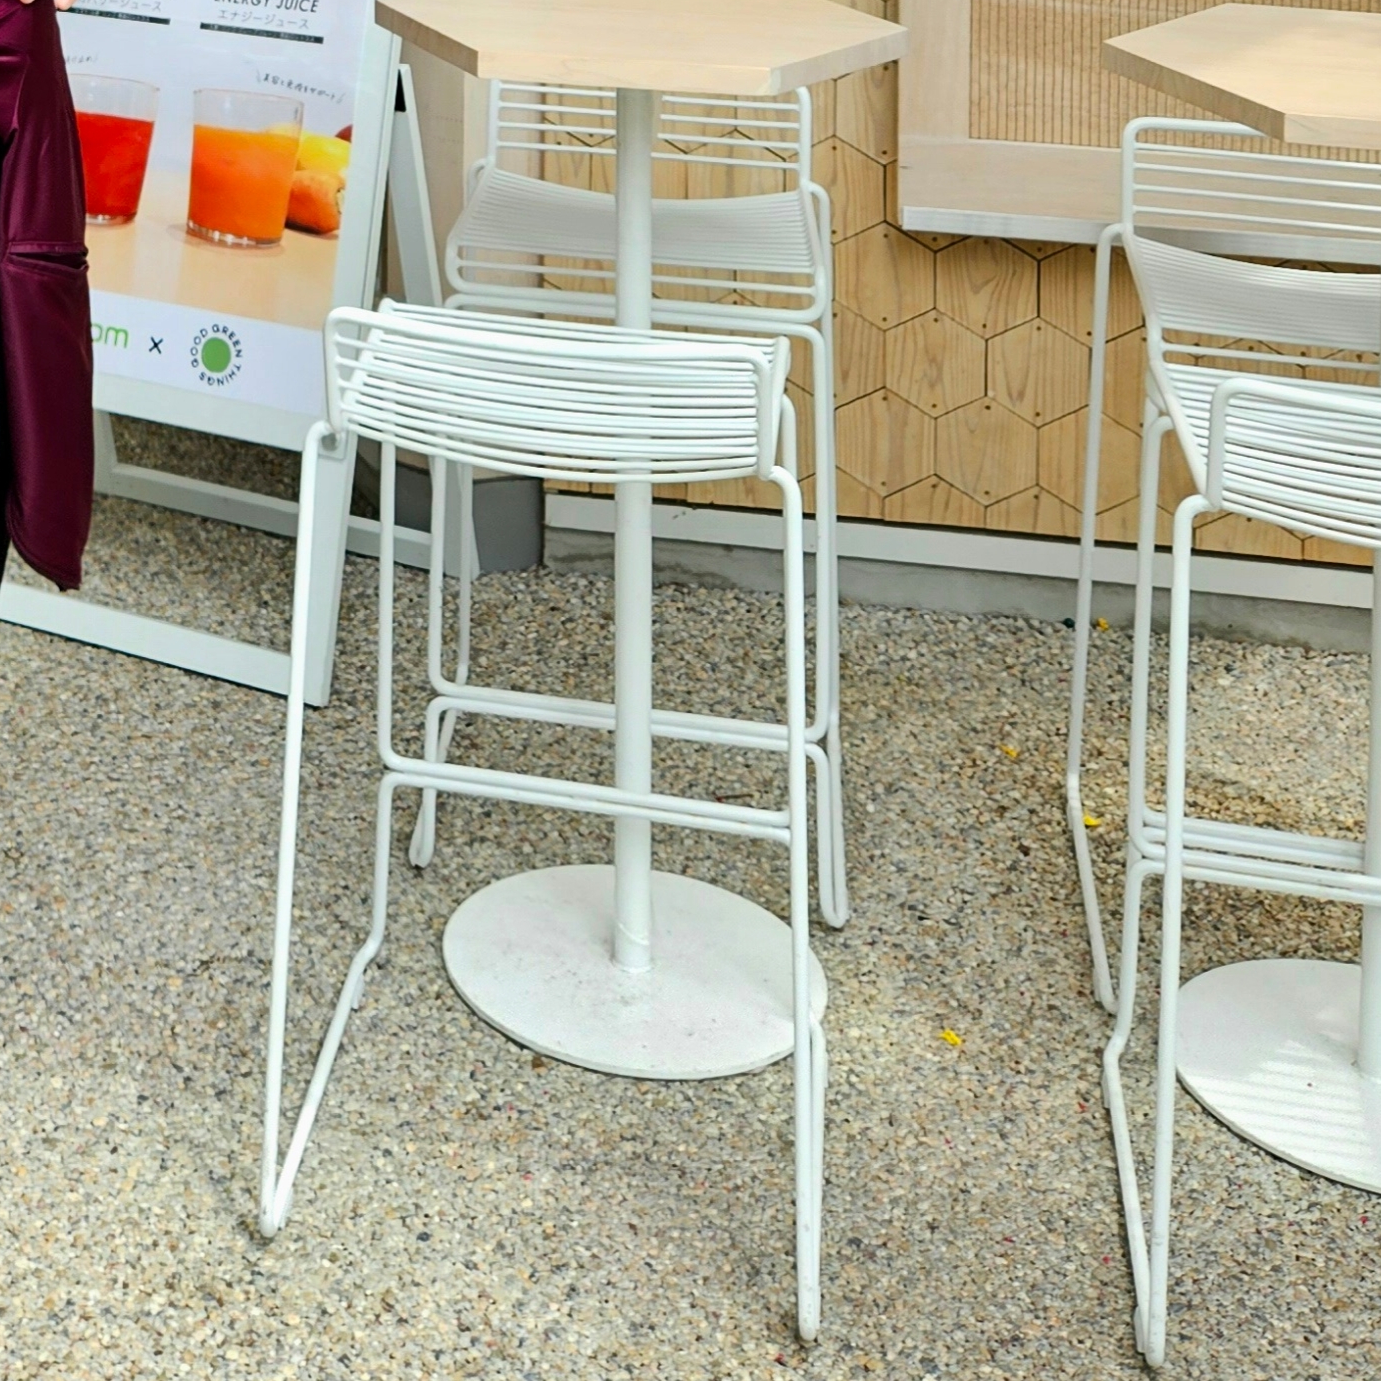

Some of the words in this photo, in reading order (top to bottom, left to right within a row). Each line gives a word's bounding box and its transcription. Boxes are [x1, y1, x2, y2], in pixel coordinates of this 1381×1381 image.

[217, 9, 309, 30] エナジージュース
[190, 328, 208, 368] GOOD
[212, 324, 244, 358] GREEN
[199, 363, 242, 386] THINGS
